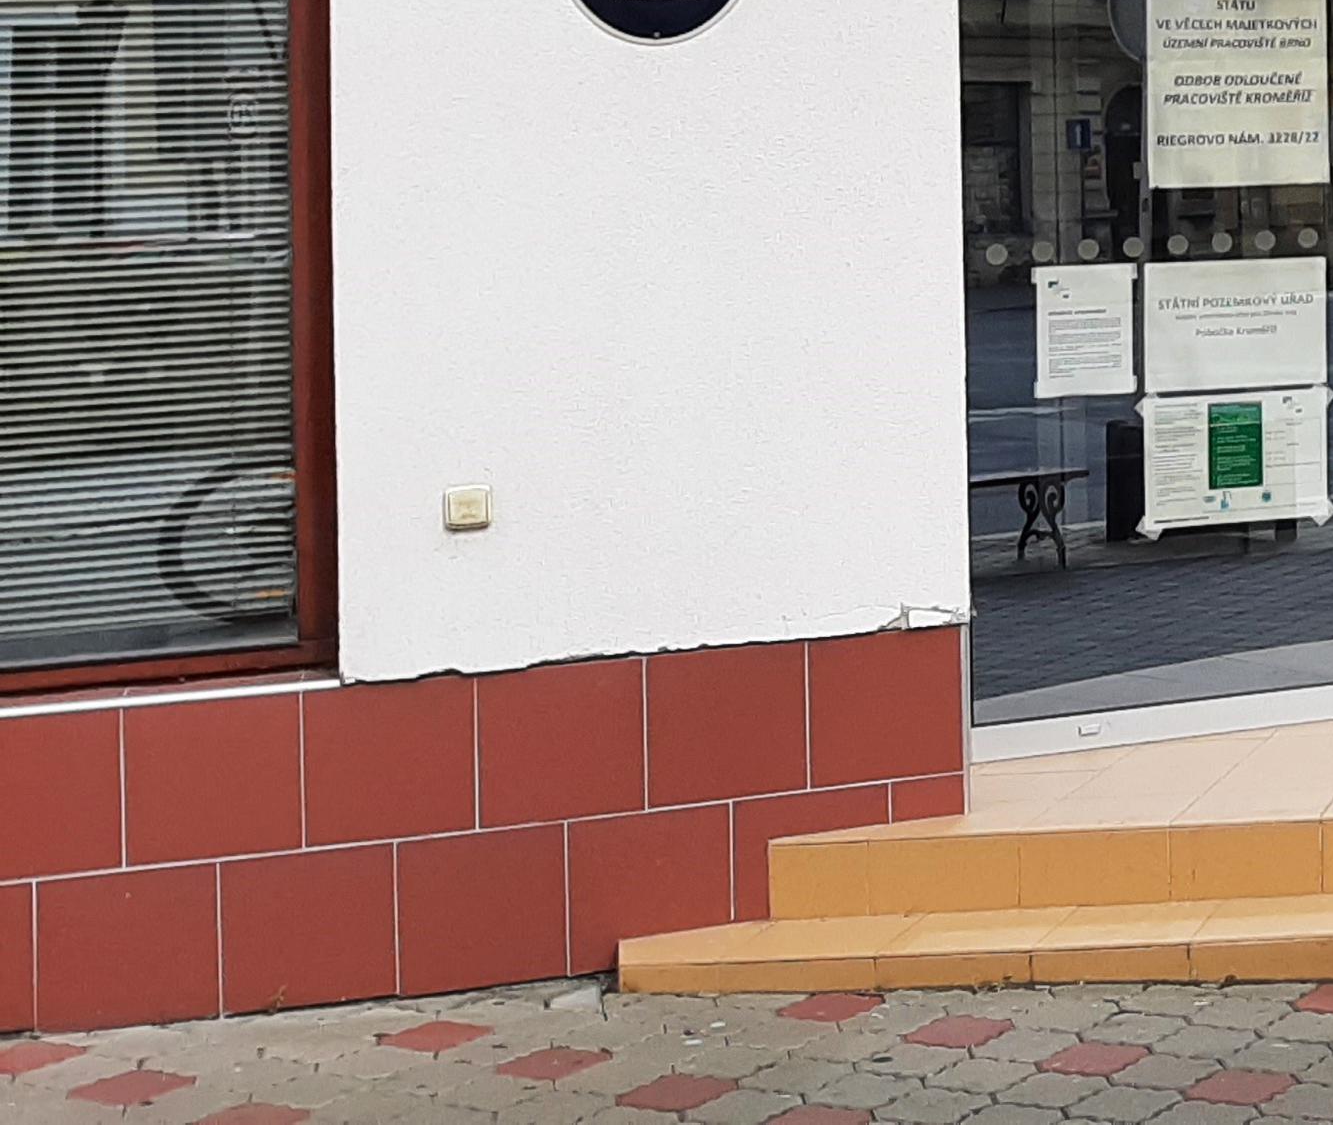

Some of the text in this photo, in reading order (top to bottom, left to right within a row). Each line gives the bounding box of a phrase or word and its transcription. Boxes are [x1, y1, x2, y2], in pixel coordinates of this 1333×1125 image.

[1156, 19, 1171, 30] VE
[1156, 134, 1225, 147] RIEGROVO
[1158, 296, 1199, 311] STÁTNÍ
